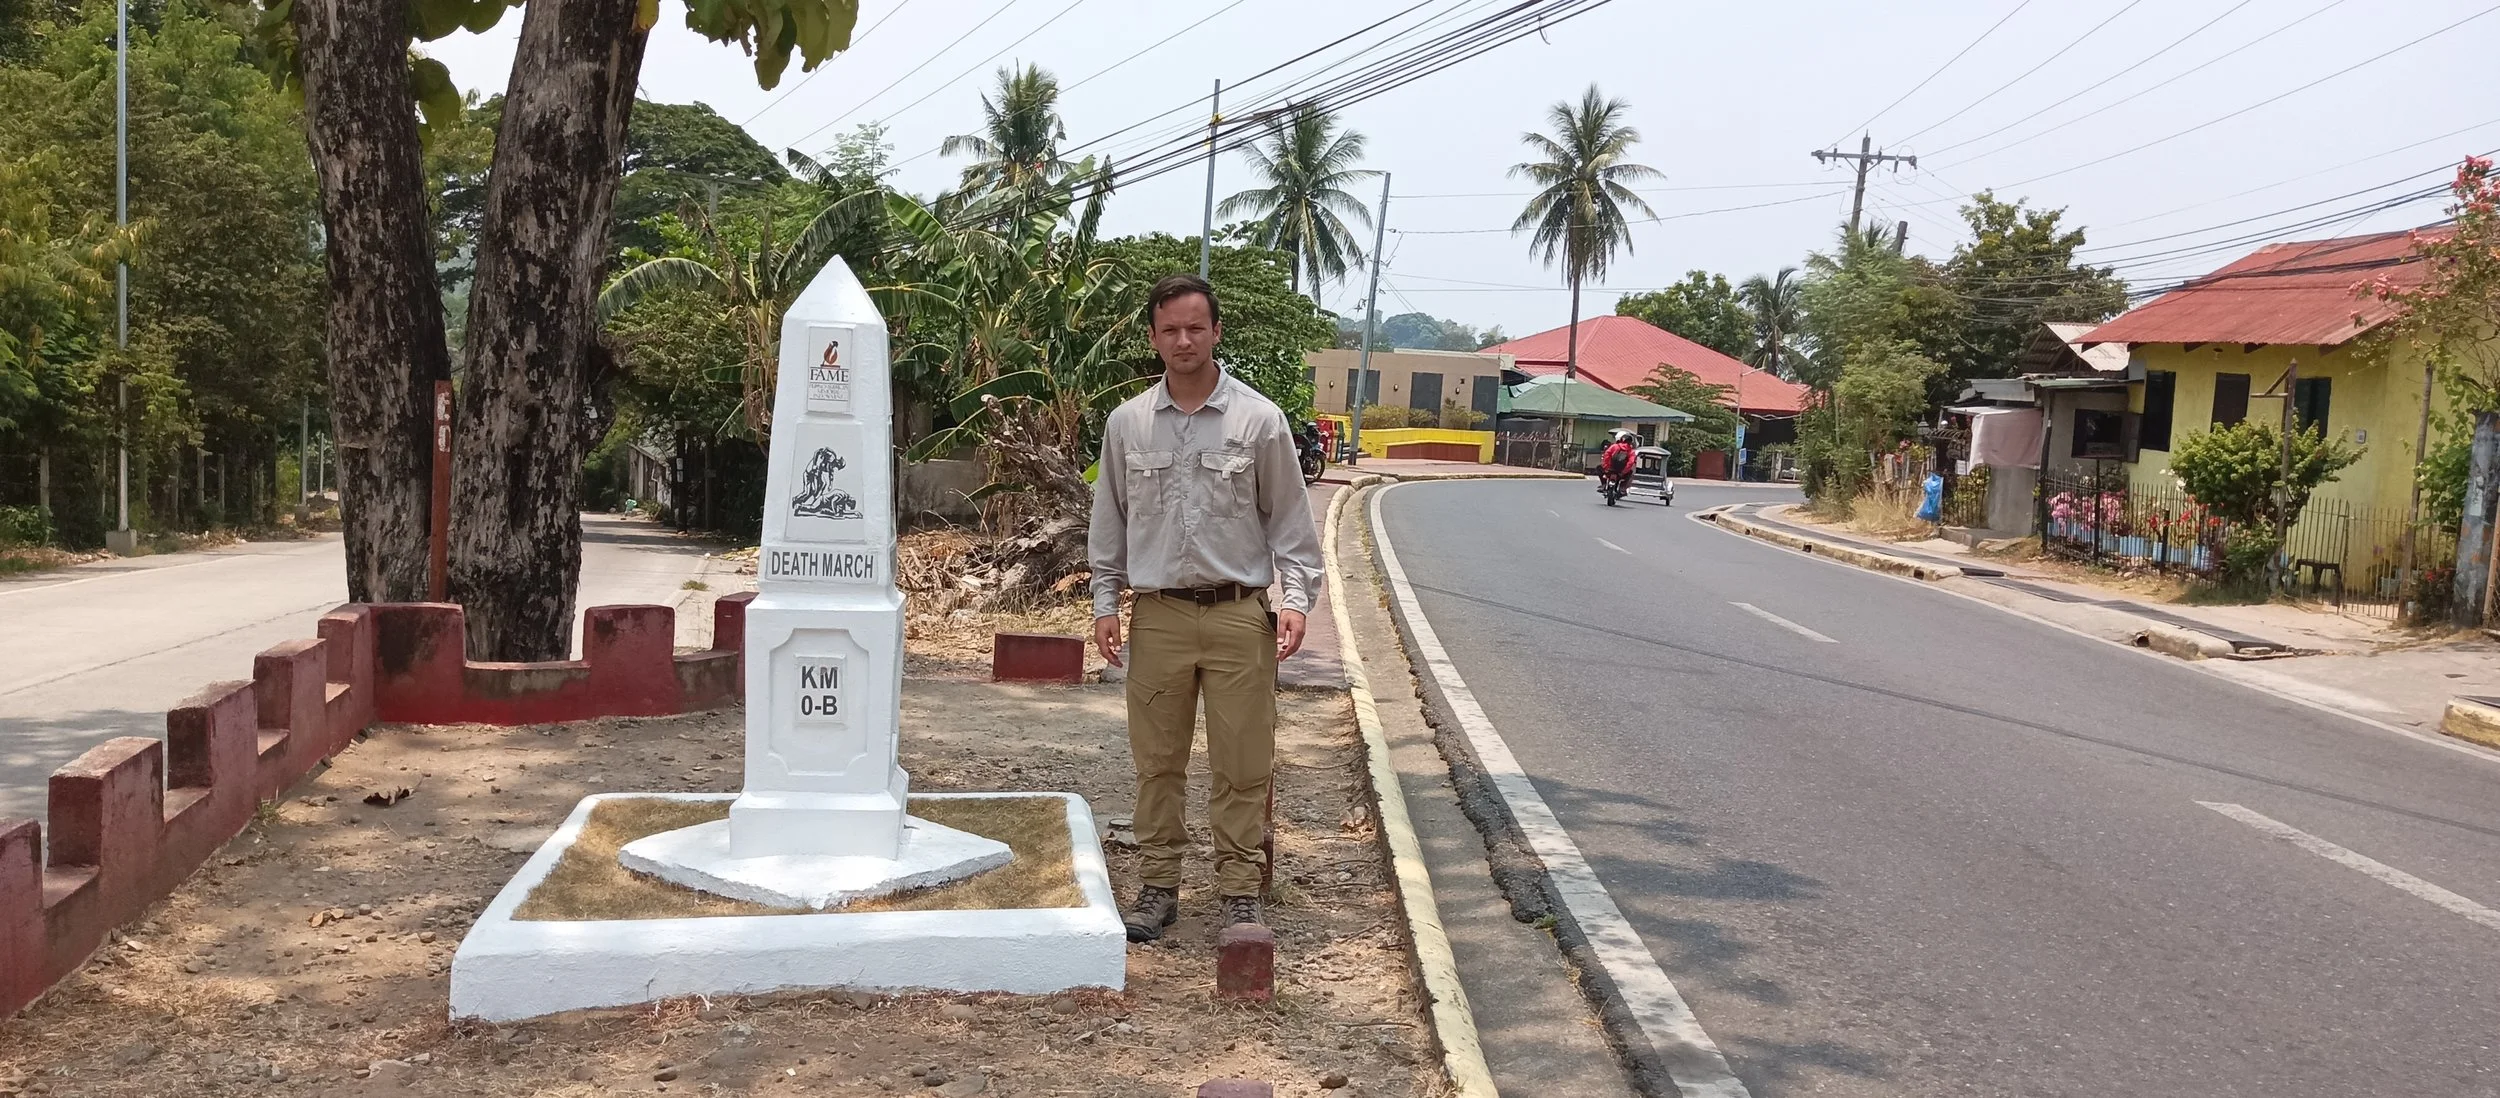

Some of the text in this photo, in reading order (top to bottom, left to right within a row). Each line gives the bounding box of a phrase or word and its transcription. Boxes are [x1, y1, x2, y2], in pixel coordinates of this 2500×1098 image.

[810, 369, 849, 382] FAME
[772, 551, 873, 578] DEATH MARCH
[801, 666, 838, 689] KM
[801, 695, 838, 716] 0-B
